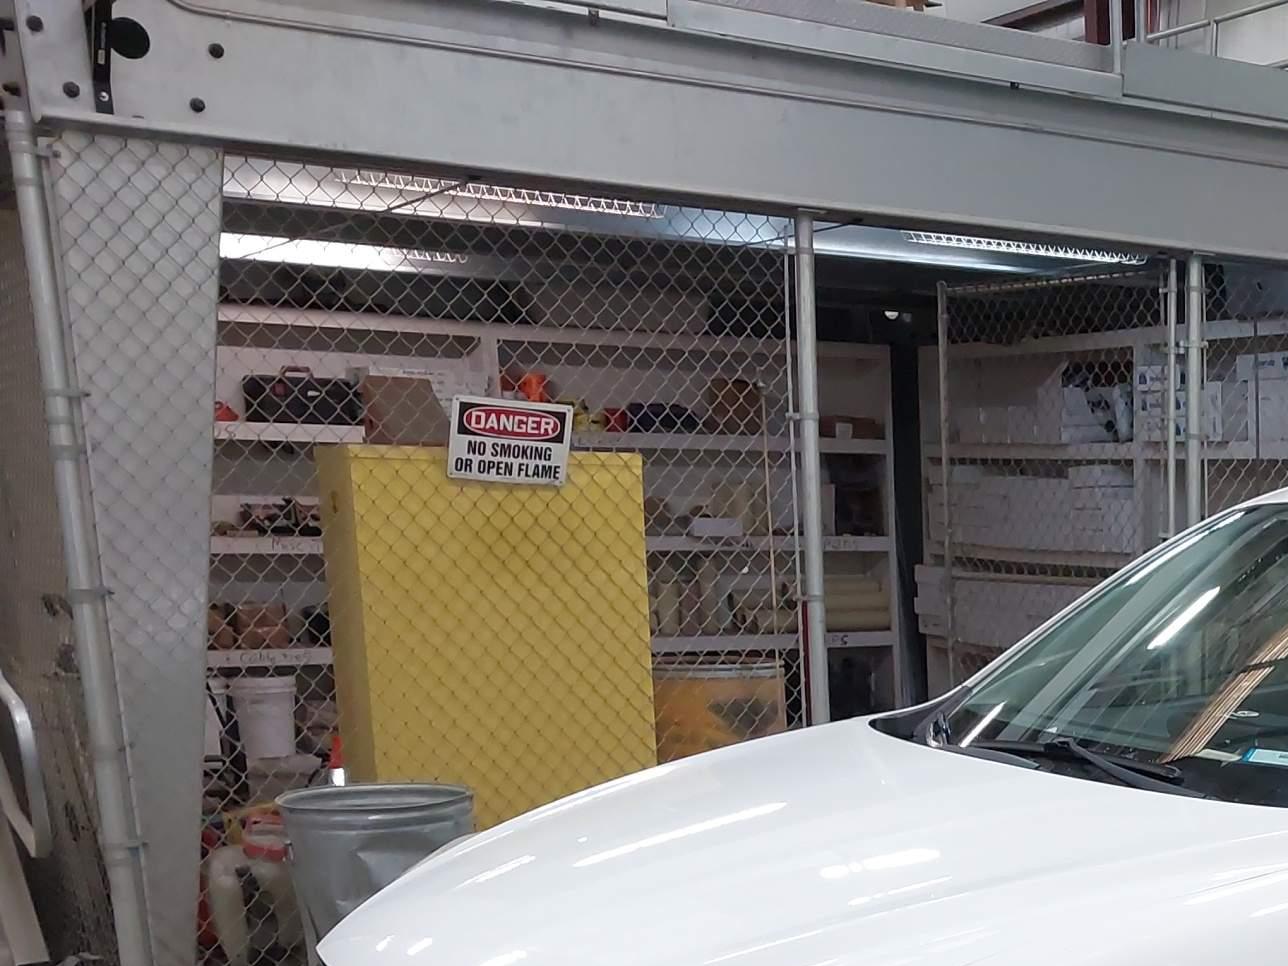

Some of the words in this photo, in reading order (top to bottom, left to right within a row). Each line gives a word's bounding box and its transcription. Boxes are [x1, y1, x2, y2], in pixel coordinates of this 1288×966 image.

[470, 411, 554, 435] DANGER
[467, 440, 486, 456] NO
[491, 441, 553, 461] SMOKING
[454, 457, 473, 473] OR
[478, 459, 513, 477] OPEN
[517, 463, 561, 480] FLAME
